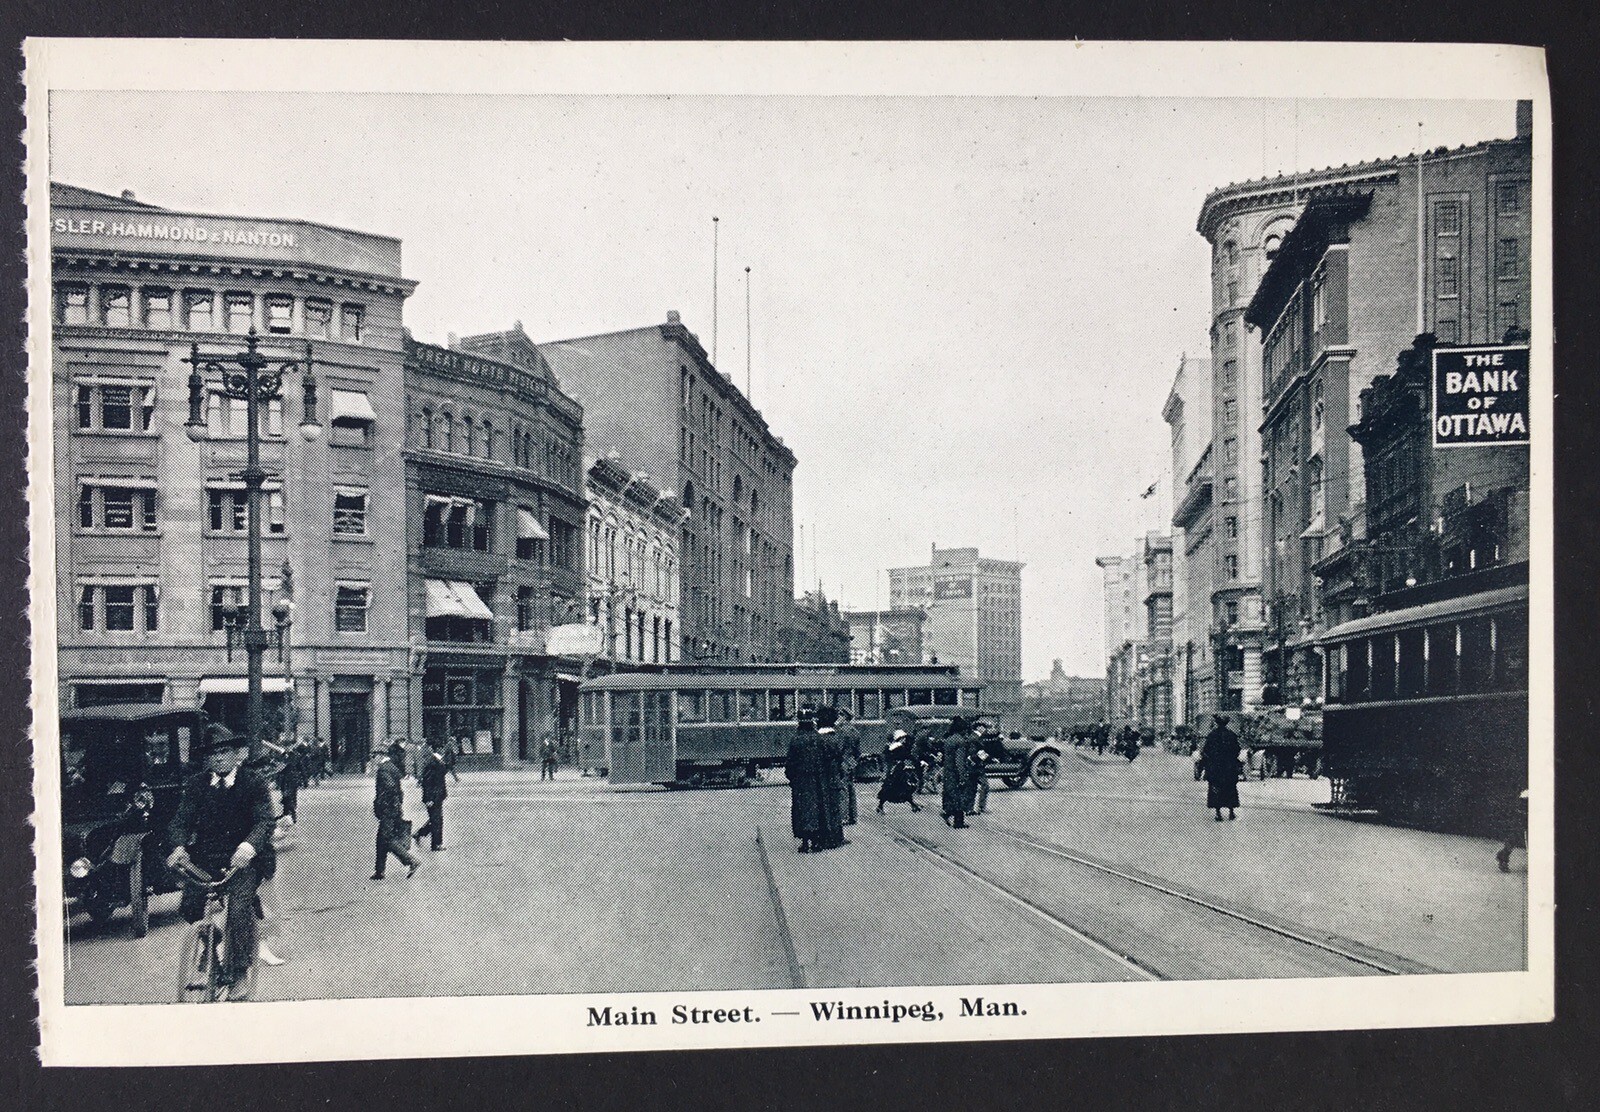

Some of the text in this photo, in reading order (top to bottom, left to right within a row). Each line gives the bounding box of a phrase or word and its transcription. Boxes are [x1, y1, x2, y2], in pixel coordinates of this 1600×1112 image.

[112, 221, 207, 241] HAMMOND
[416, 347, 458, 369] GREAT
[464, 360, 504, 381] NORTH
[1463, 353, 1504, 367] THE
[1445, 370, 1519, 394] BANK
[1467, 396, 1498, 410] OF
[1437, 412, 1527, 437] OTTAWA
[587, 1006, 658, 1026] Main
[672, 1004, 761, 1025] Street.
[809, 1000, 944, 1023] Winnipeg,
[959, 997, 1027, 1017] Man.
